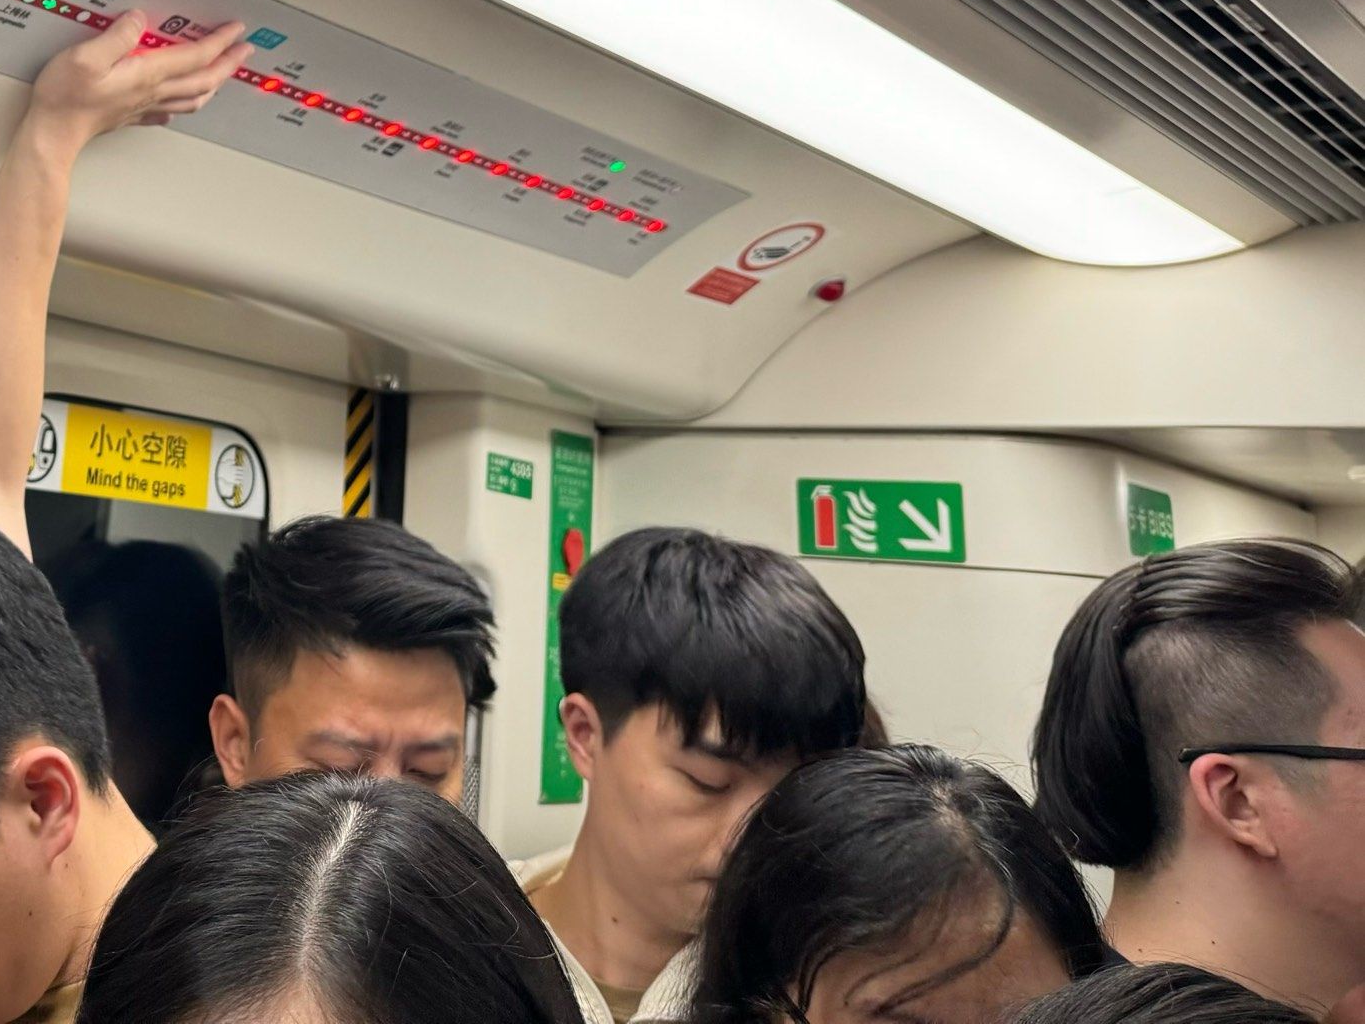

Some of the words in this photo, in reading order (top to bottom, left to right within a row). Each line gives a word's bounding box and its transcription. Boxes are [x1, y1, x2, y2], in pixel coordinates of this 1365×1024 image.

[90, 424, 188, 469] 小心空隙
[86, 467, 121, 488] Mind
[126, 473, 148, 492] the
[151, 480, 186, 499] gaps
